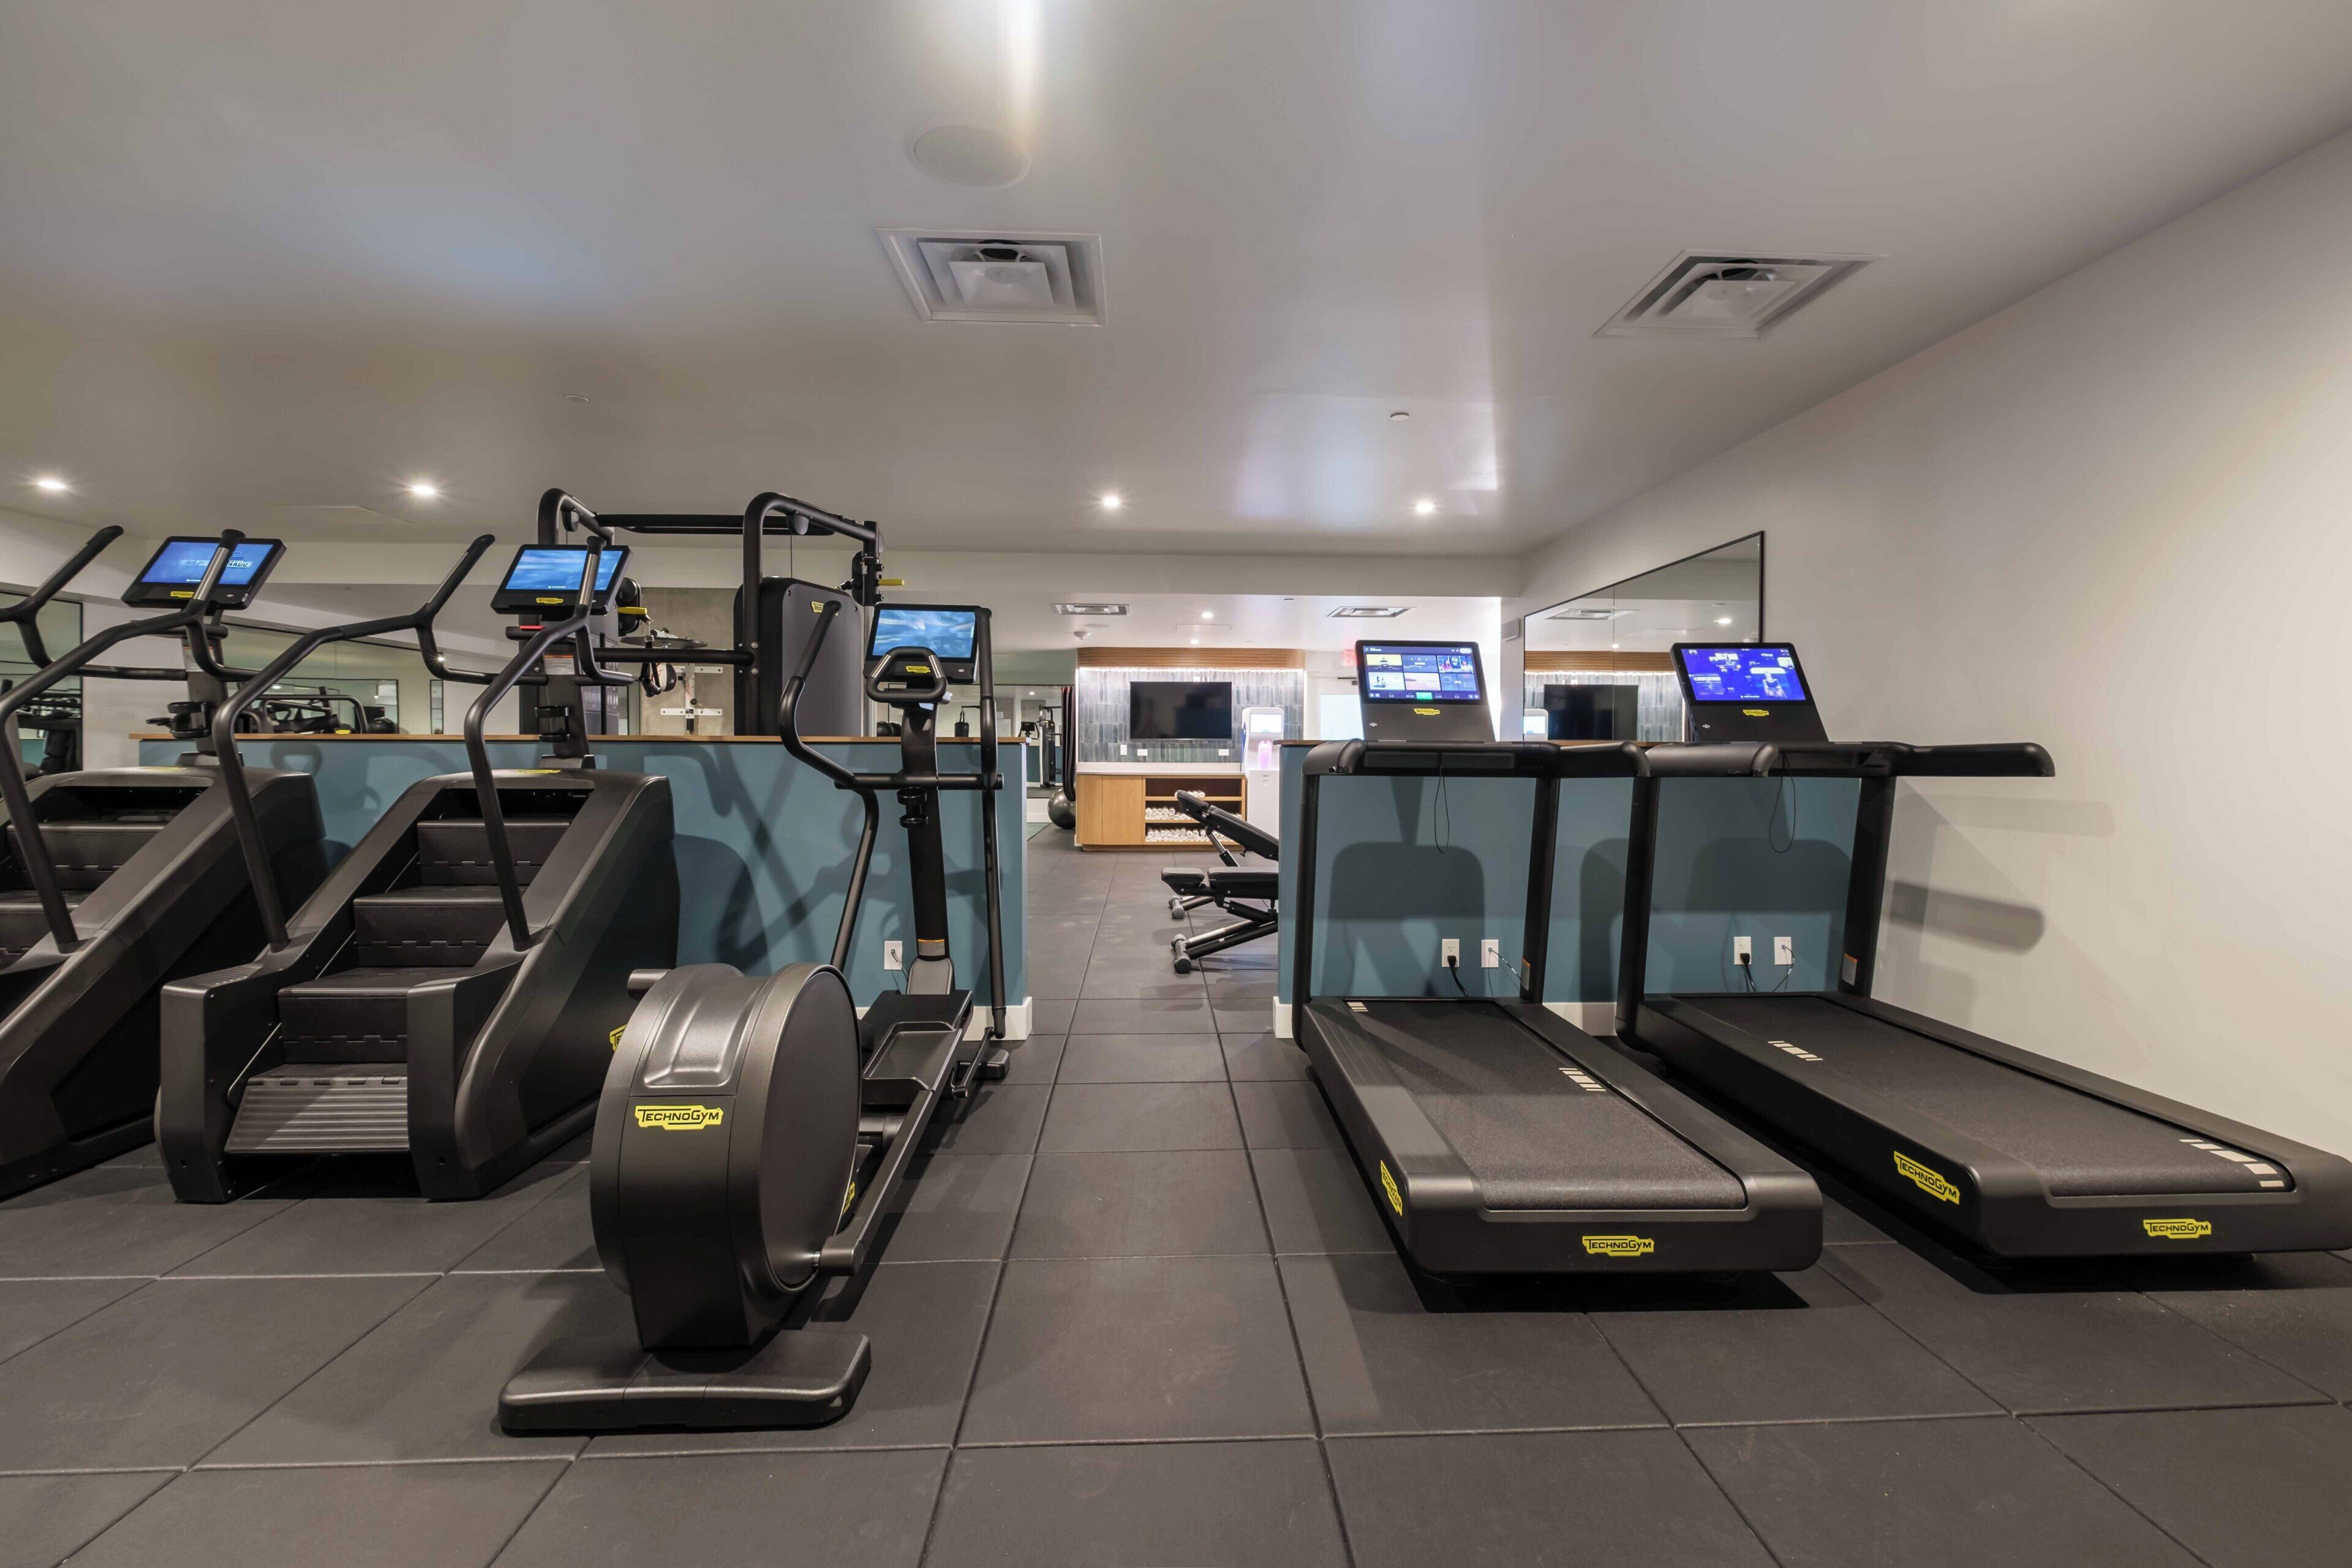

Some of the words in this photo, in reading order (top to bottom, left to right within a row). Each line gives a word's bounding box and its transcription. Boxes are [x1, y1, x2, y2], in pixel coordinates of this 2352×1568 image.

[637, 1108, 720, 1125] TECHNOGYM
[1895, 1155, 1958, 1199] TECHNOGYM
[2145, 1221, 2209, 1235] TECHNOGYM
[1583, 1238, 1652, 1253] TECHNOGYM
